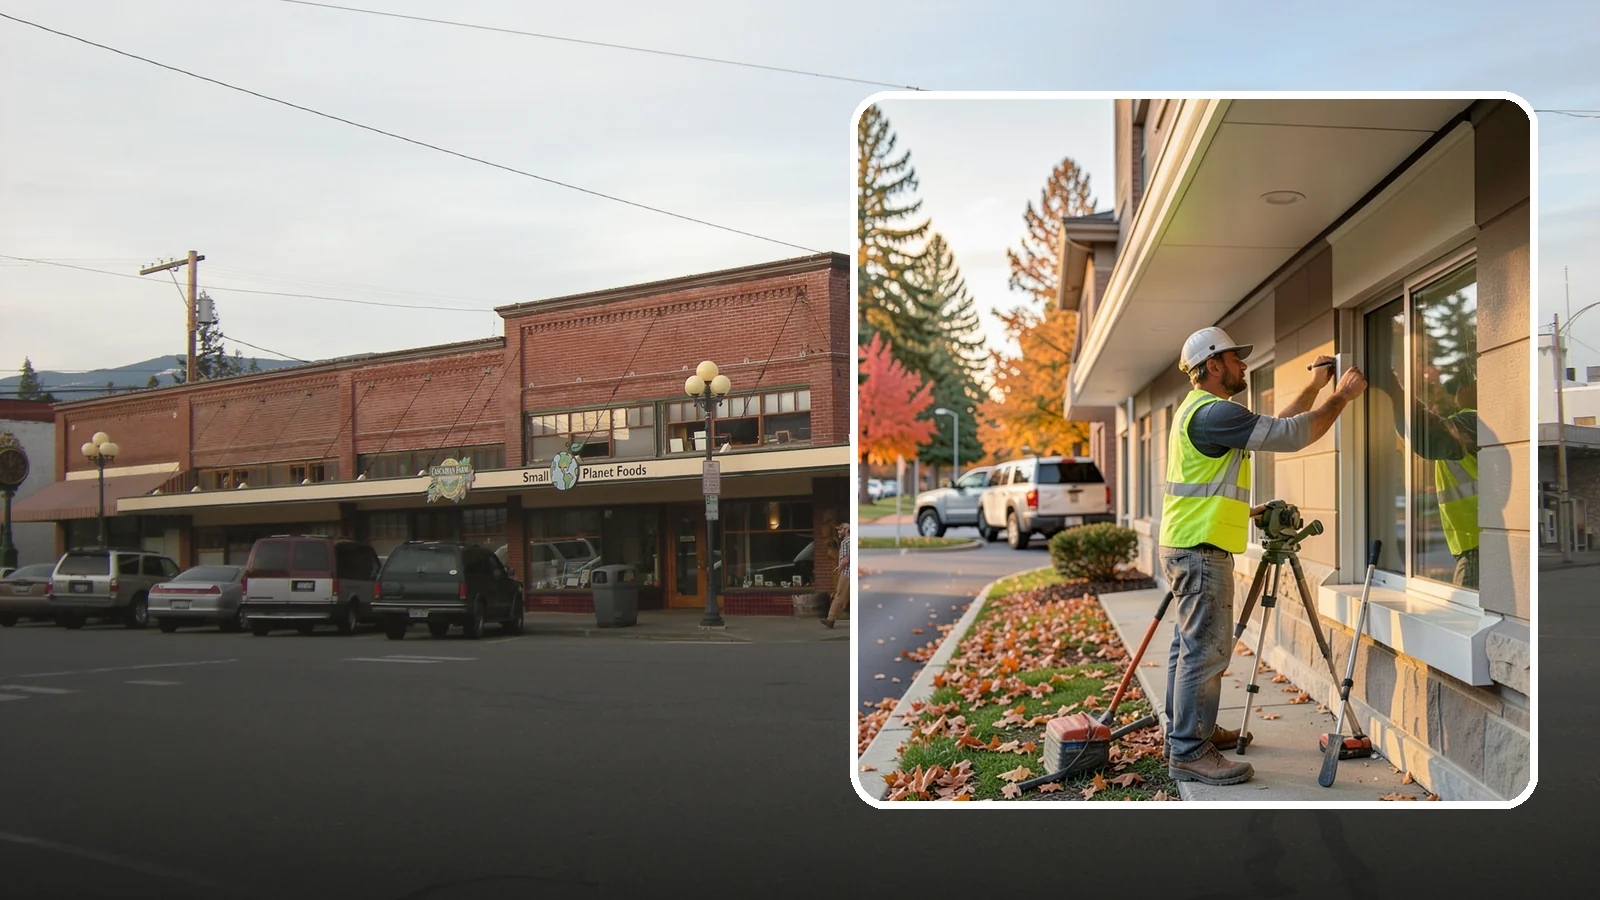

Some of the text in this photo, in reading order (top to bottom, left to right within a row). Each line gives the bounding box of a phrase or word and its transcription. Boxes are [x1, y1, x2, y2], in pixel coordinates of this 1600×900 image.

[523, 464, 647, 483] Small Planet Foods
